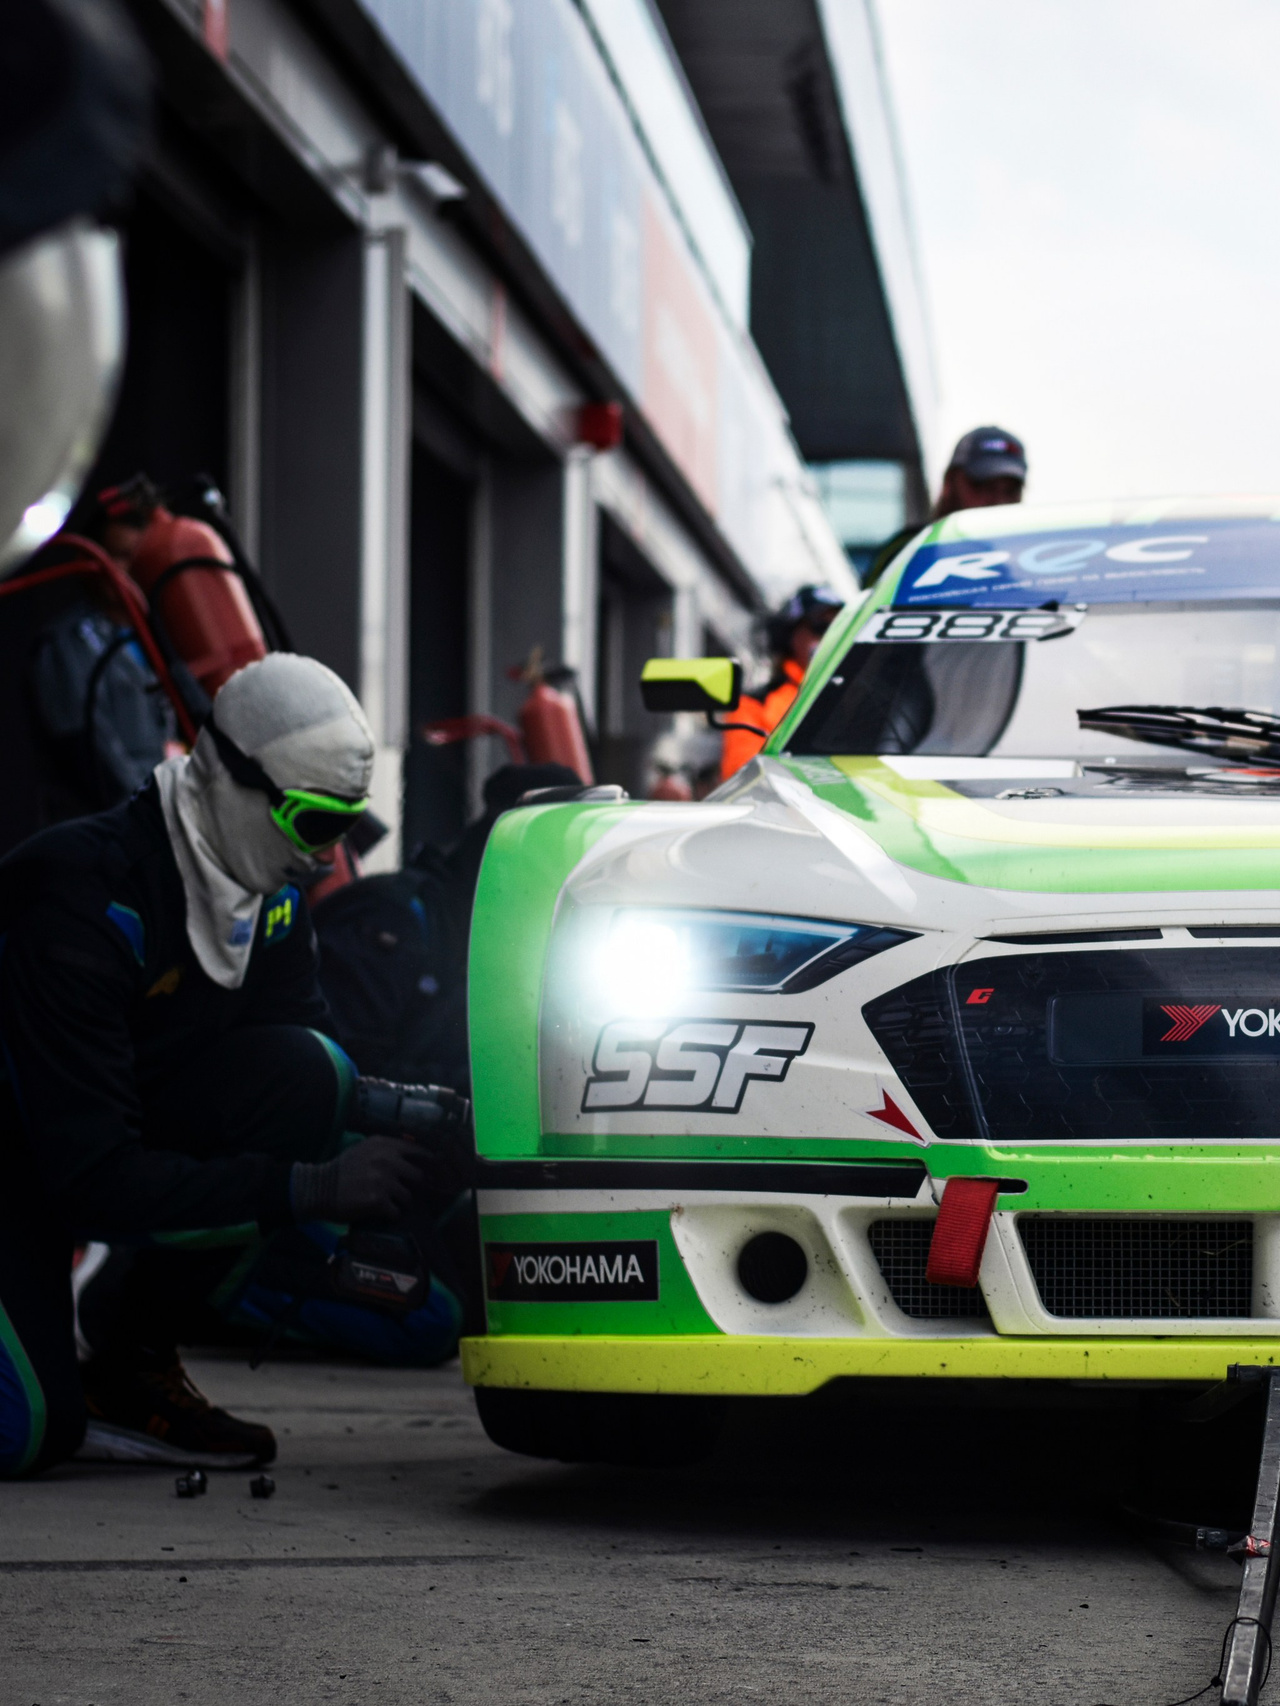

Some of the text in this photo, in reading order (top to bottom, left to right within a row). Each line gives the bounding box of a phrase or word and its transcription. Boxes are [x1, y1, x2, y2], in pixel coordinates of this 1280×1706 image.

[875, 613, 1066, 640] 888
[581, 1018, 815, 1115] SSF
[514, 1254, 645, 1286] YOKOHAMA
